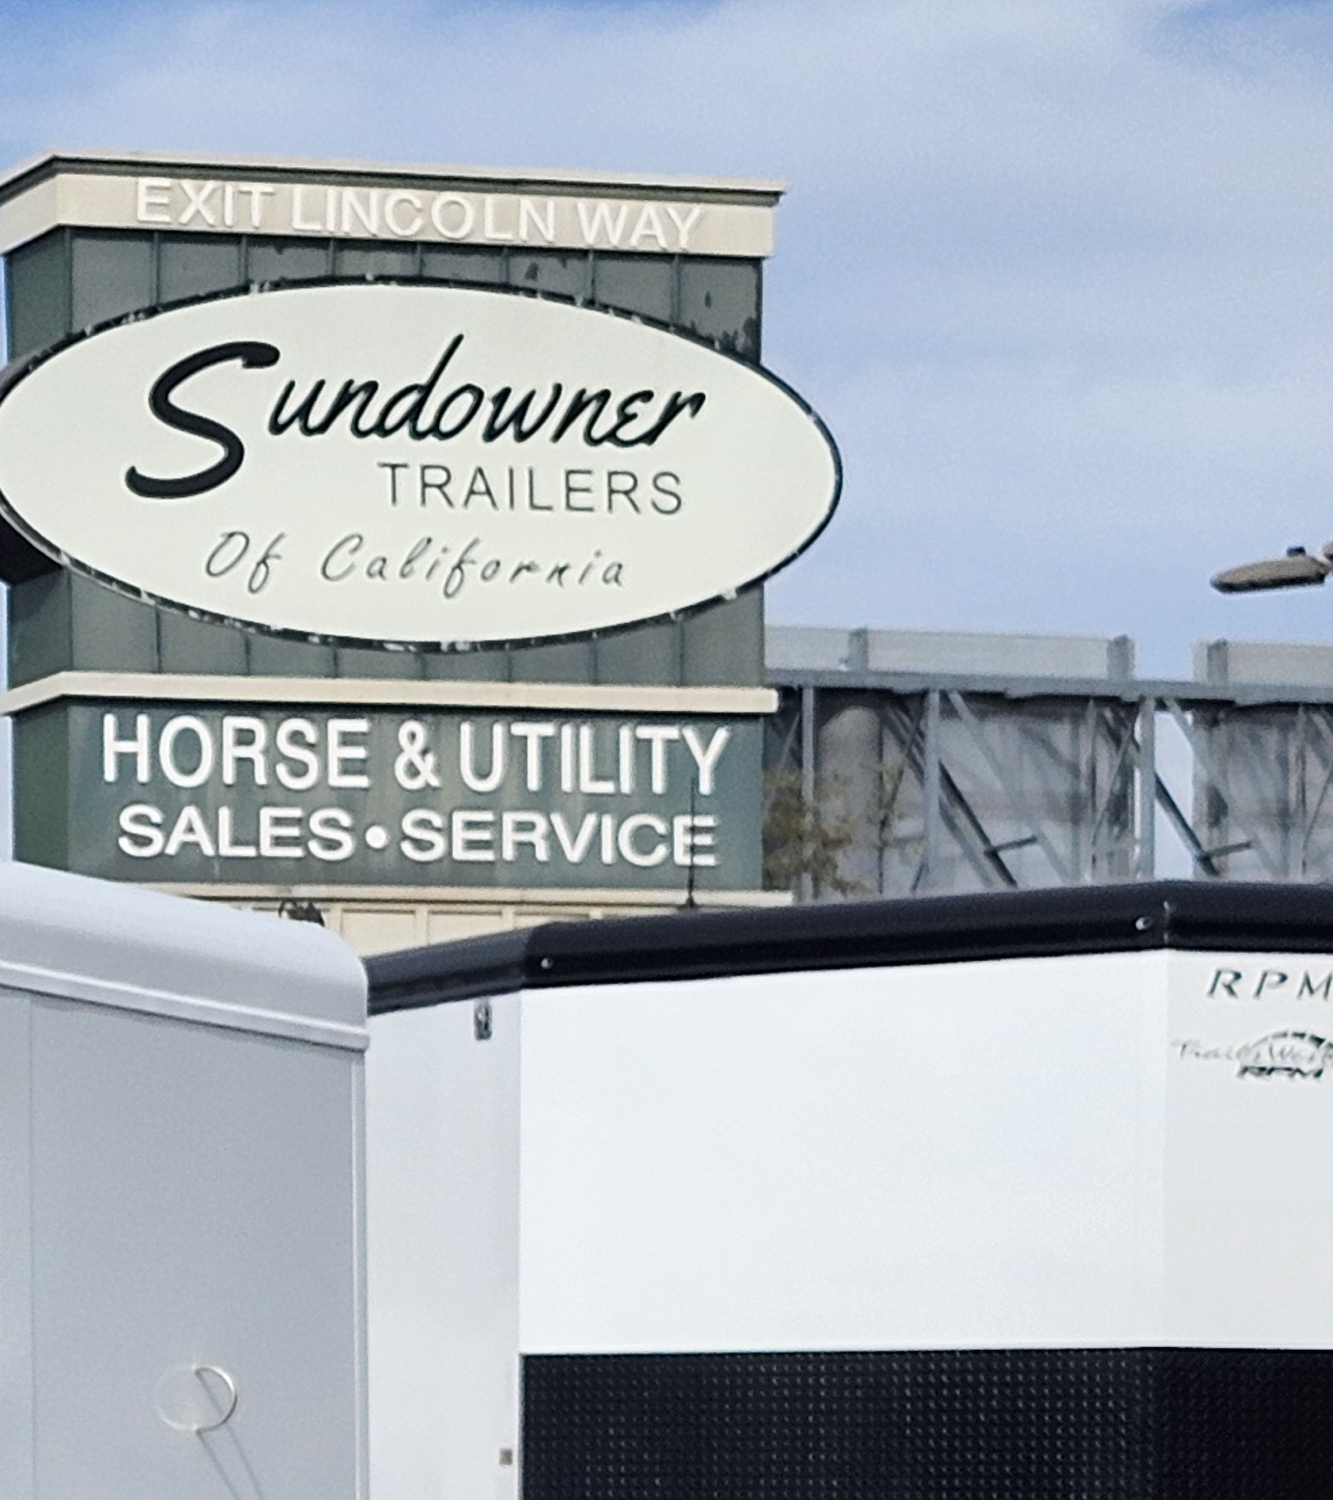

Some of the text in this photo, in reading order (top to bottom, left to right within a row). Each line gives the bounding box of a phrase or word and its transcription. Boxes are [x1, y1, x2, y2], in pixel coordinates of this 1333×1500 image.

[135, 177, 701, 251] EXIT LINCOLN WAY
[125, 333, 706, 499] Sundowner
[377, 461, 683, 515] TRAILERS
[204, 530, 624, 598] Of California
[103, 713, 730, 796] HORSE & UTILITY
[118, 804, 719, 866] SALES SERVICE
[1206, 969, 1333, 1000] RPM
